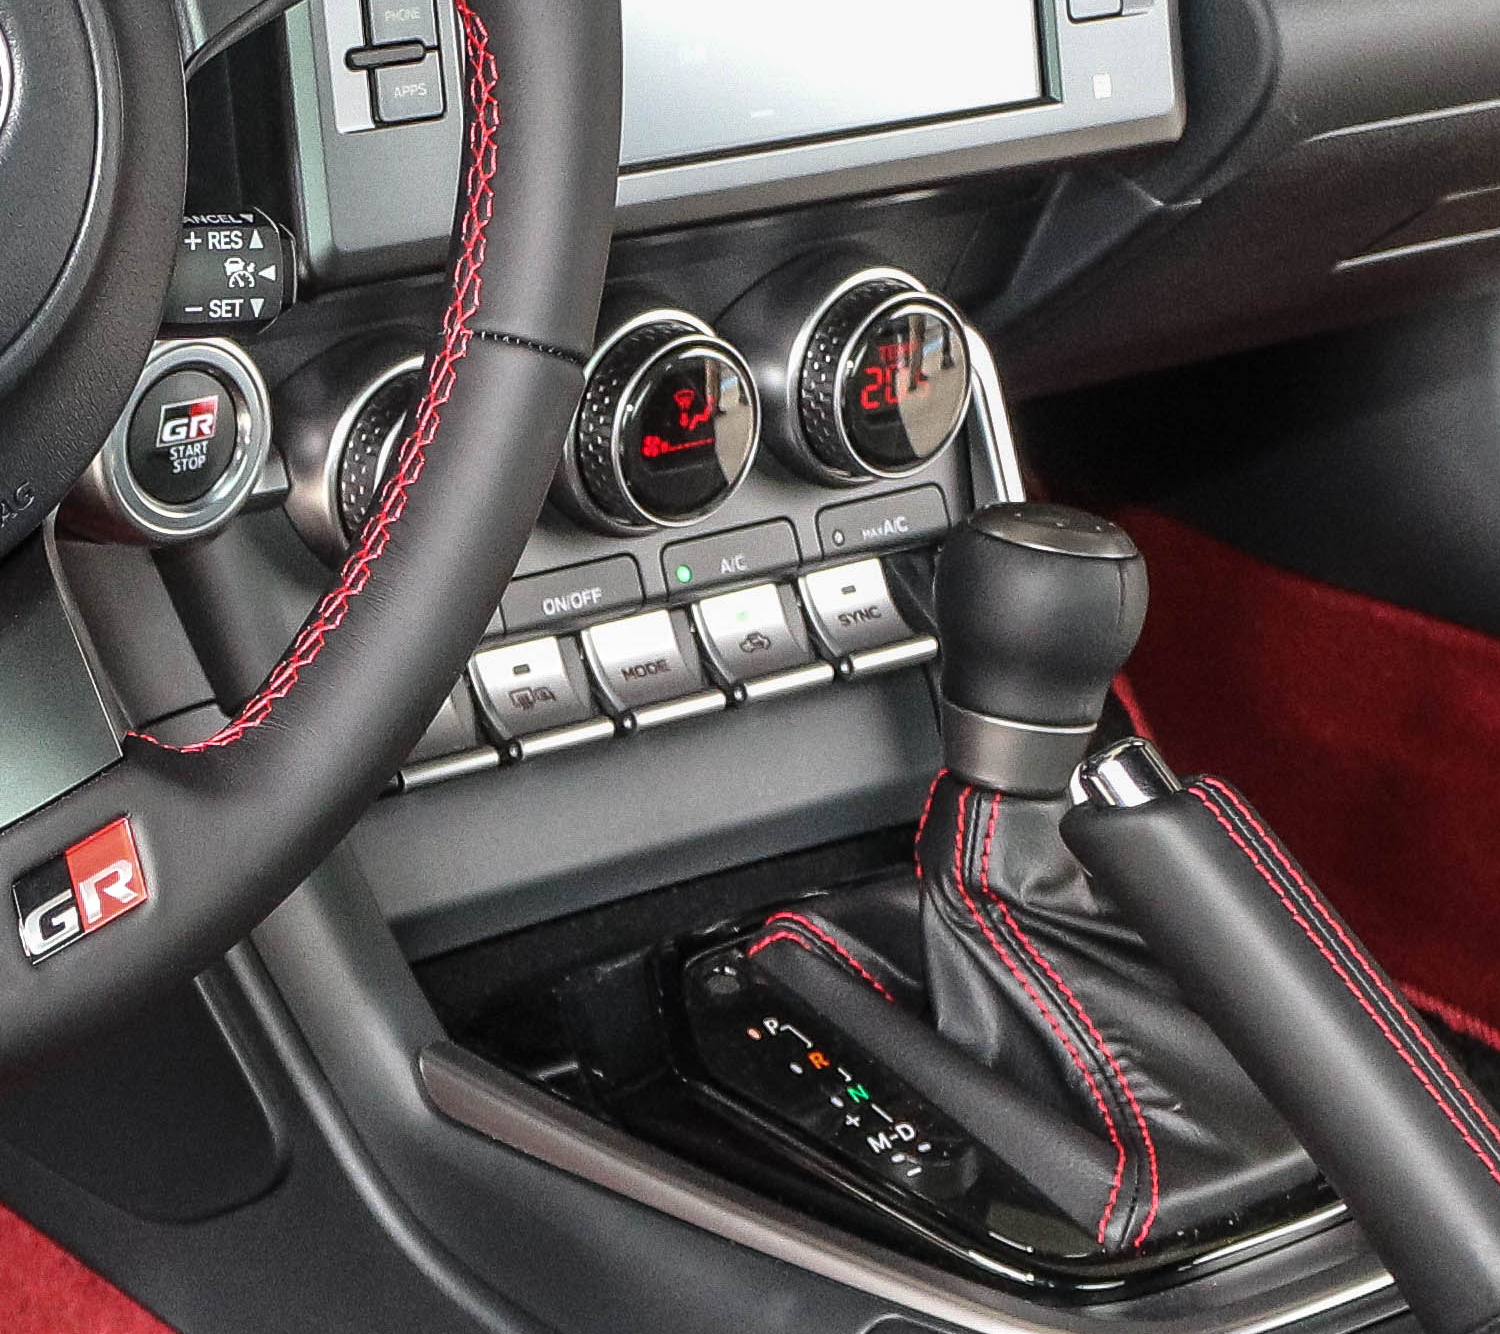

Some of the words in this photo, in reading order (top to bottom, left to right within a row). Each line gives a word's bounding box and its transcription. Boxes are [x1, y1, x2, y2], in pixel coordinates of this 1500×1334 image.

[393, 82, 428, 99] APPS
[183, 214, 244, 224] ANCEL
[207, 230, 243, 250] RES
[208, 298, 245, 319] SET
[161, 413, 214, 443] GR
[169, 440, 209, 461] START
[172, 455, 207, 474] STOP
[883, 515, 909, 537] A/C
[719, 553, 749, 575] A/C
[541, 588, 603, 616] ON/OFF
[837, 605, 883, 628] SYNC
[620, 658, 672, 682] MODE
[23, 858, 141, 957] GR
[762, 1017, 780, 1036] P
[807, 1050, 831, 1070] R
[847, 1083, 870, 1104] N
